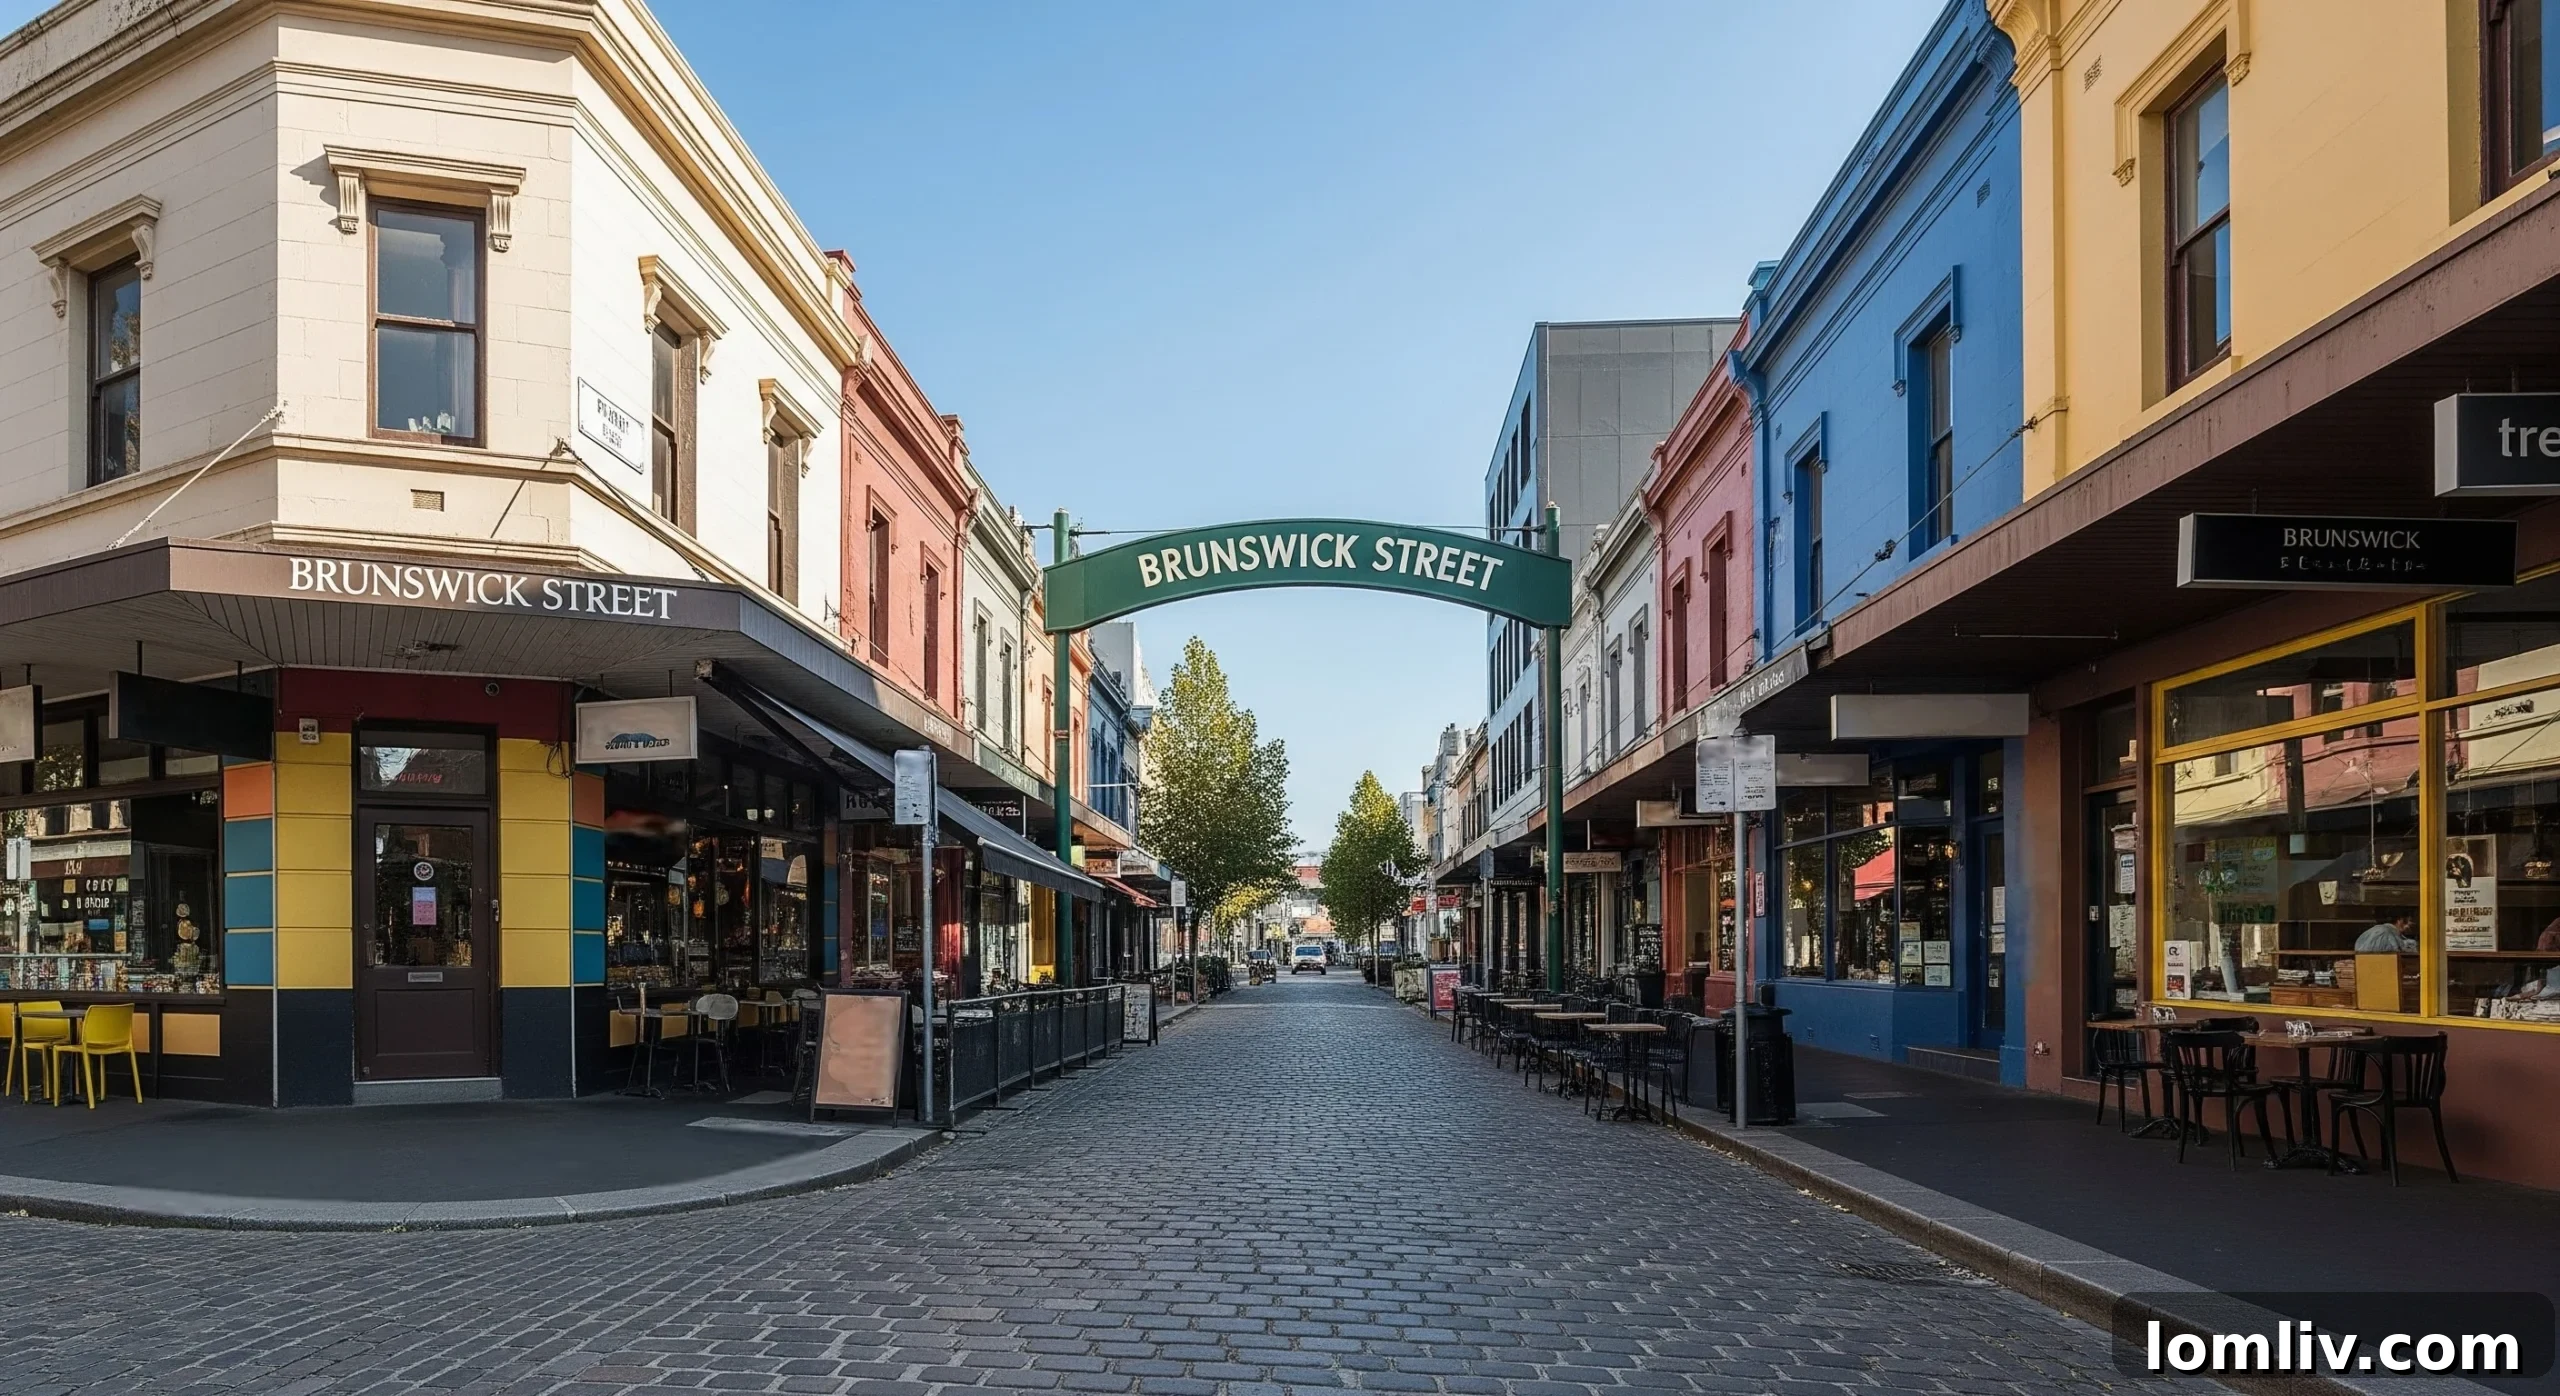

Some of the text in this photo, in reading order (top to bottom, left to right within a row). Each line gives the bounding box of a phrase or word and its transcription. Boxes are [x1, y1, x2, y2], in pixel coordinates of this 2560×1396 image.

[2498, 417, 2560, 458] tre
[1137, 532, 1504, 591] BRUNSWICK STREET
[2283, 527, 2421, 550] BRUNSWICK
[288, 557, 678, 620] BRUNSWICK STREET
